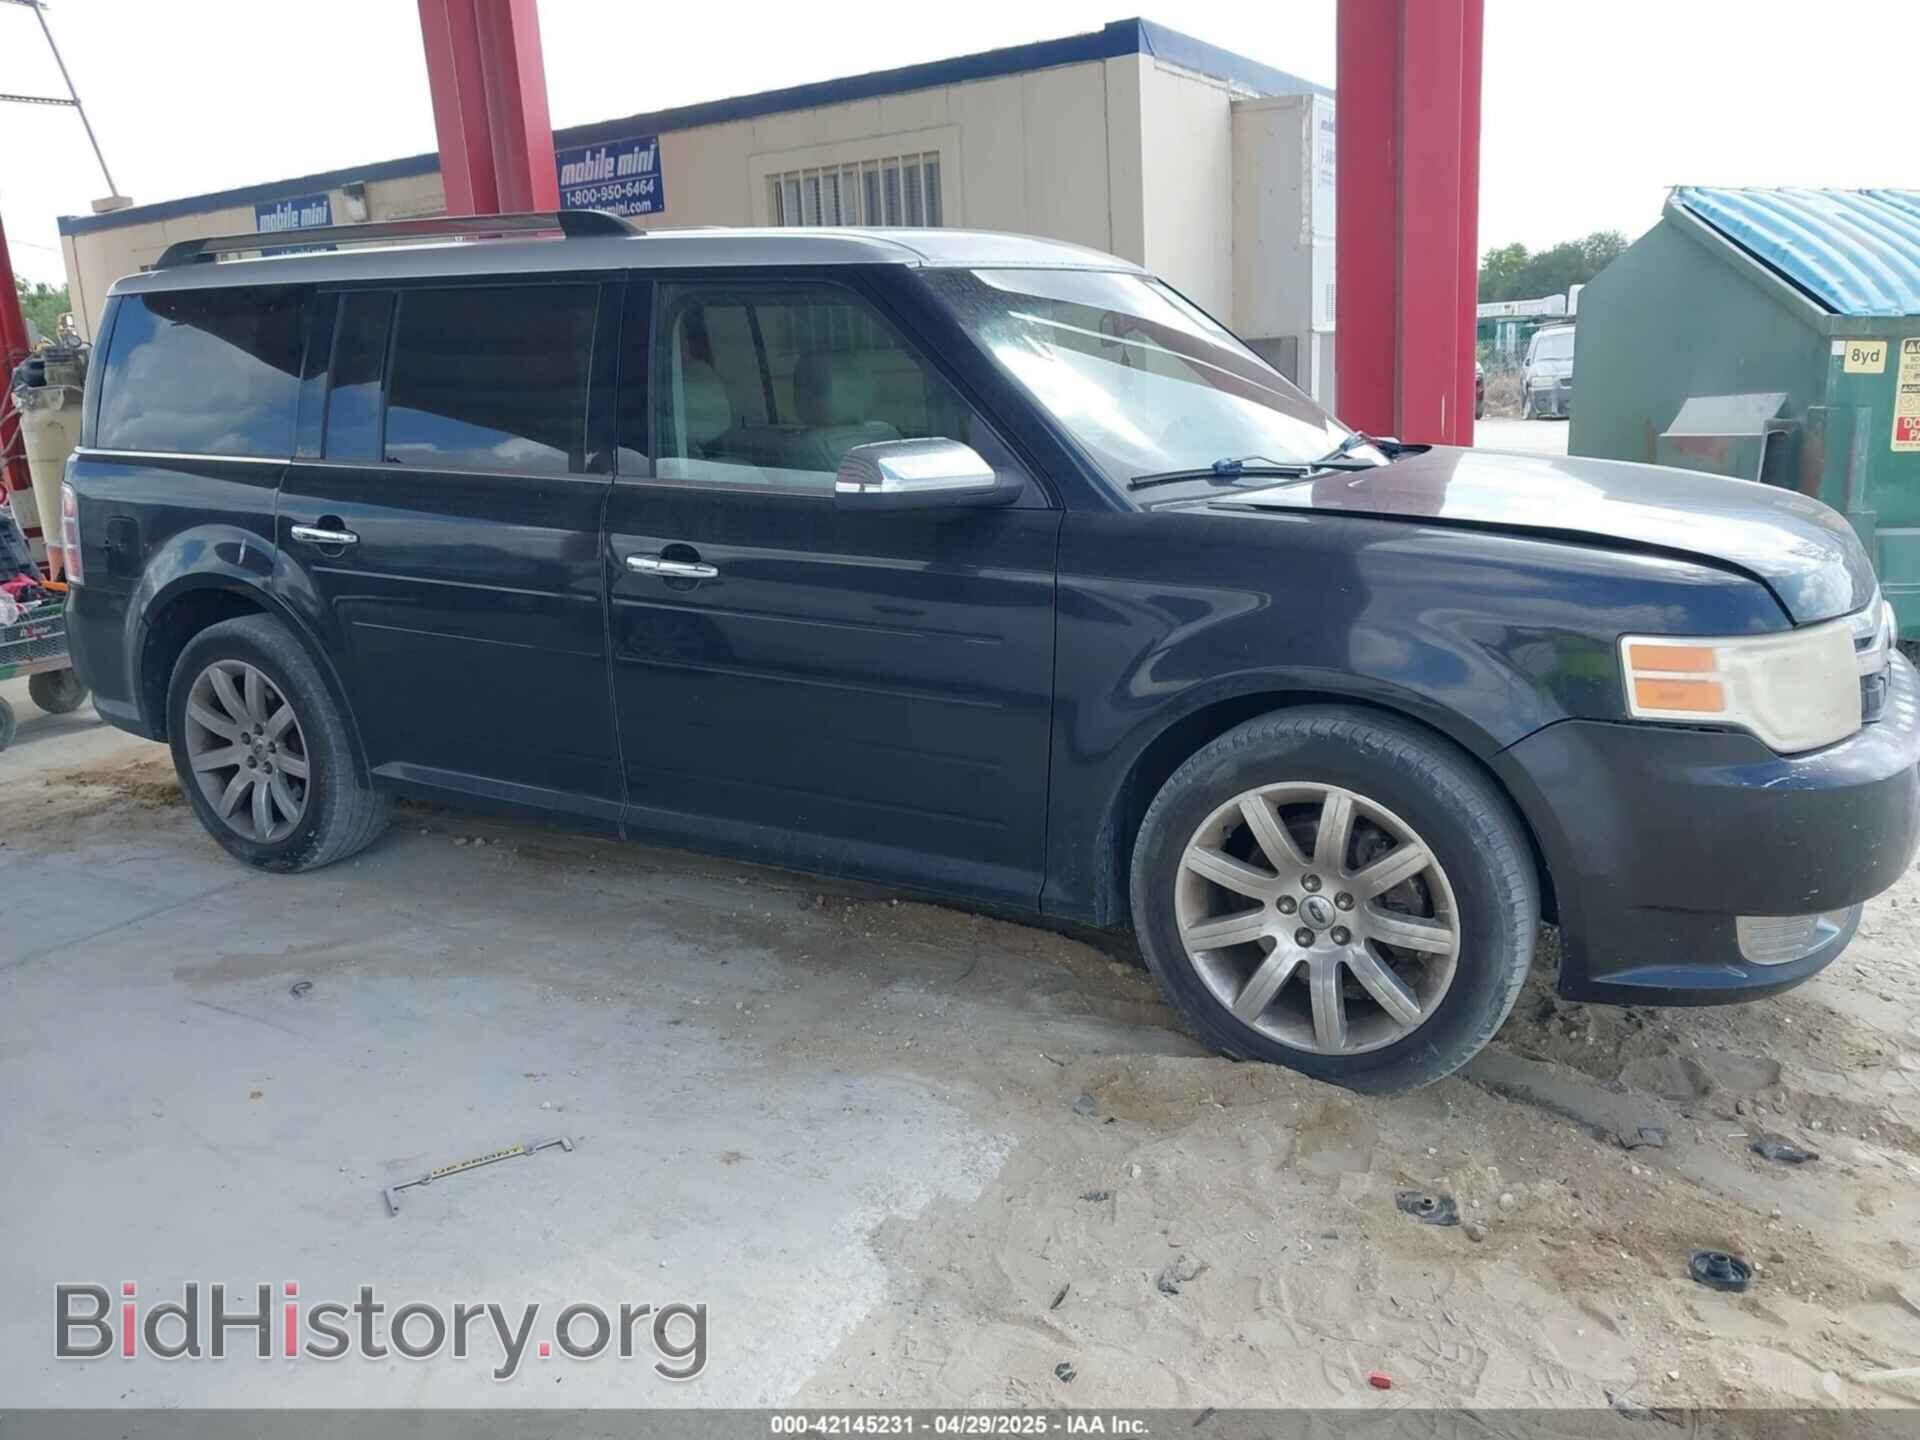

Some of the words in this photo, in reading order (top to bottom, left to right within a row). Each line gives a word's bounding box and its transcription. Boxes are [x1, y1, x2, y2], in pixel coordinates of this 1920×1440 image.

[561, 147, 615, 185] mobile
[617, 143, 656, 176] mini
[566, 178, 655, 206] 1-800-950-6464
[260, 202, 299, 232] mobile
[301, 201, 328, 228] mini
[1851, 348, 1880, 366] 8yd
